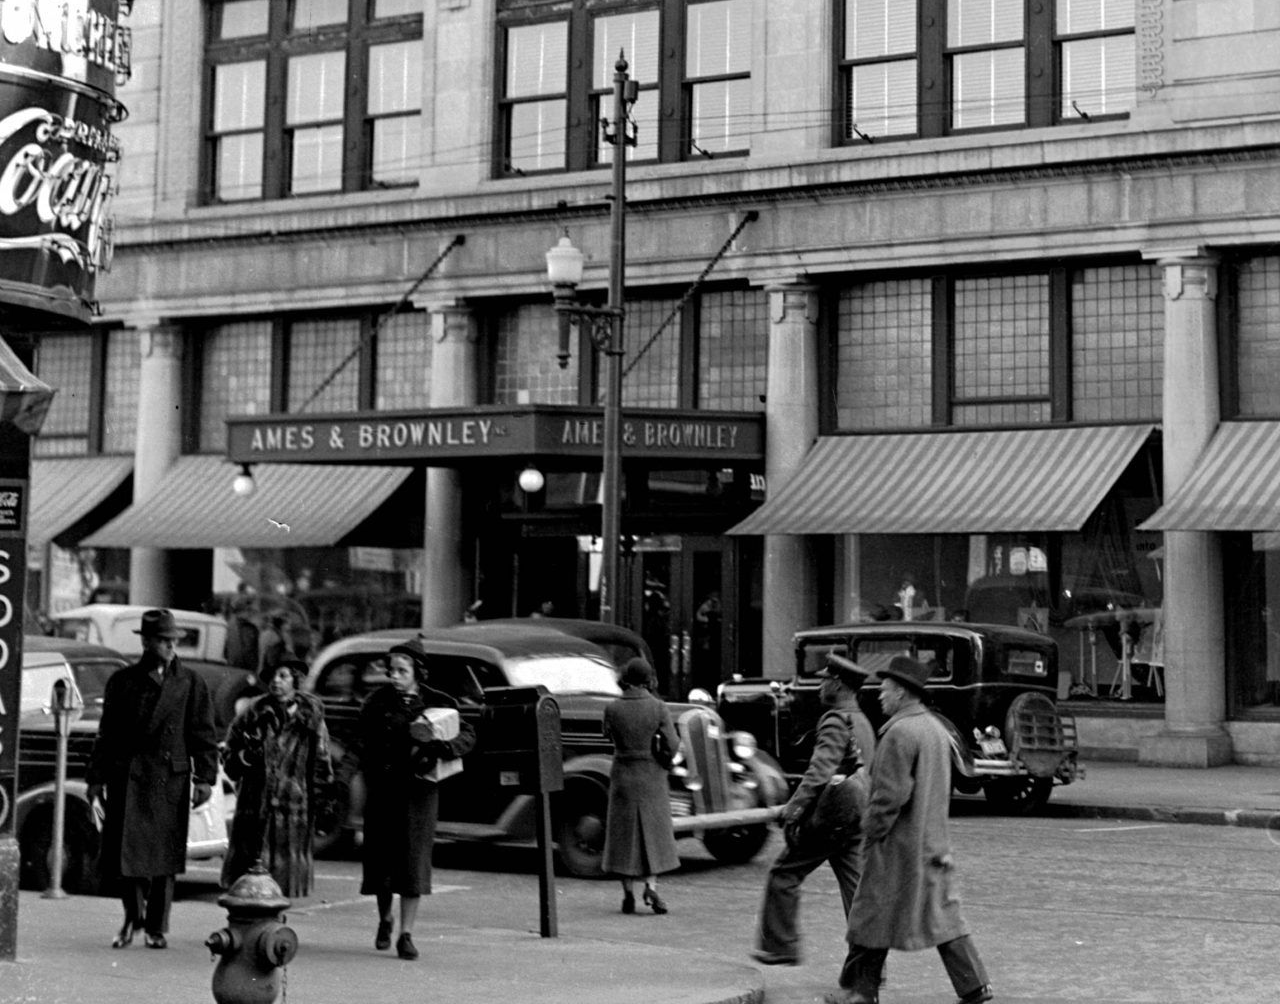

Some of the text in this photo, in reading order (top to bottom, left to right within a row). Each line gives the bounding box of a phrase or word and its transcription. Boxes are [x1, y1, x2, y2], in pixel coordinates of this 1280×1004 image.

[250, 419, 491, 451] AMES & BROWNLEY
[561, 419, 738, 448] AME & BROWNLEY
